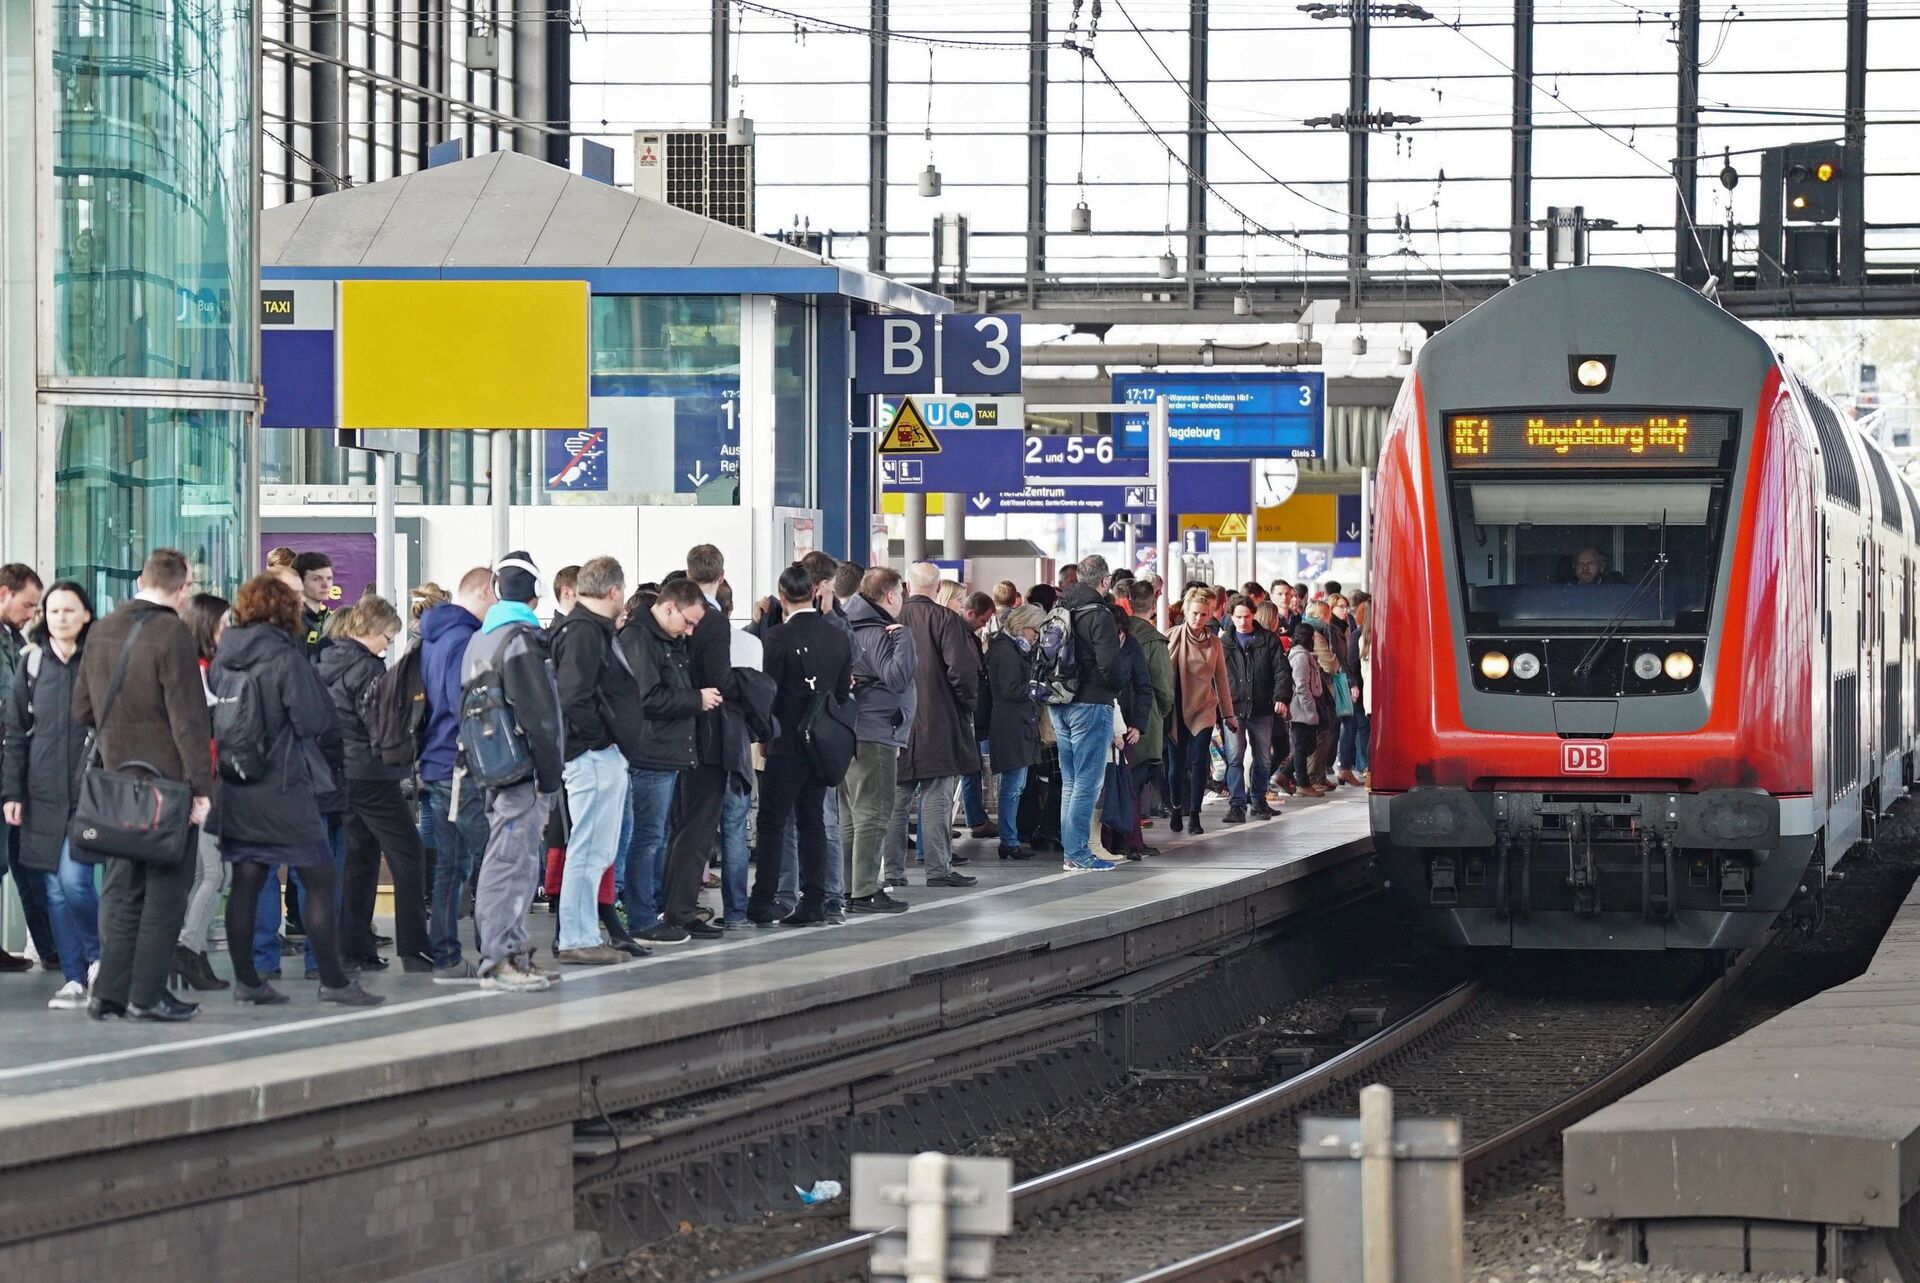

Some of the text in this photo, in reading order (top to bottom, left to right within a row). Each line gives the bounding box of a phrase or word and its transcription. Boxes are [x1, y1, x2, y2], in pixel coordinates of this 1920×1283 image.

[197, 300, 214, 312] Bus
[263, 301, 291, 313] TAXI
[883, 319, 924, 375] B
[971, 316, 1010, 376] 3
[1126, 388, 1155, 400] 17:17
[1205, 393, 1236, 402] Potsdam
[1236, 393, 1250, 402] Hbf
[1298, 385, 1311, 406] 3
[1168, 402, 1187, 410] erder
[1191, 402, 1234, 411] Brandenburg
[953, 409, 970, 419] Bus
[976, 410, 996, 419] TAXI
[1455, 419, 1688, 453] RE1 Magdeburg Hbf
[1024, 436, 1113, 464] 2 und 5-6
[1291, 449, 1316, 458] Gleis 3
[1567, 747, 1603, 769] DB
